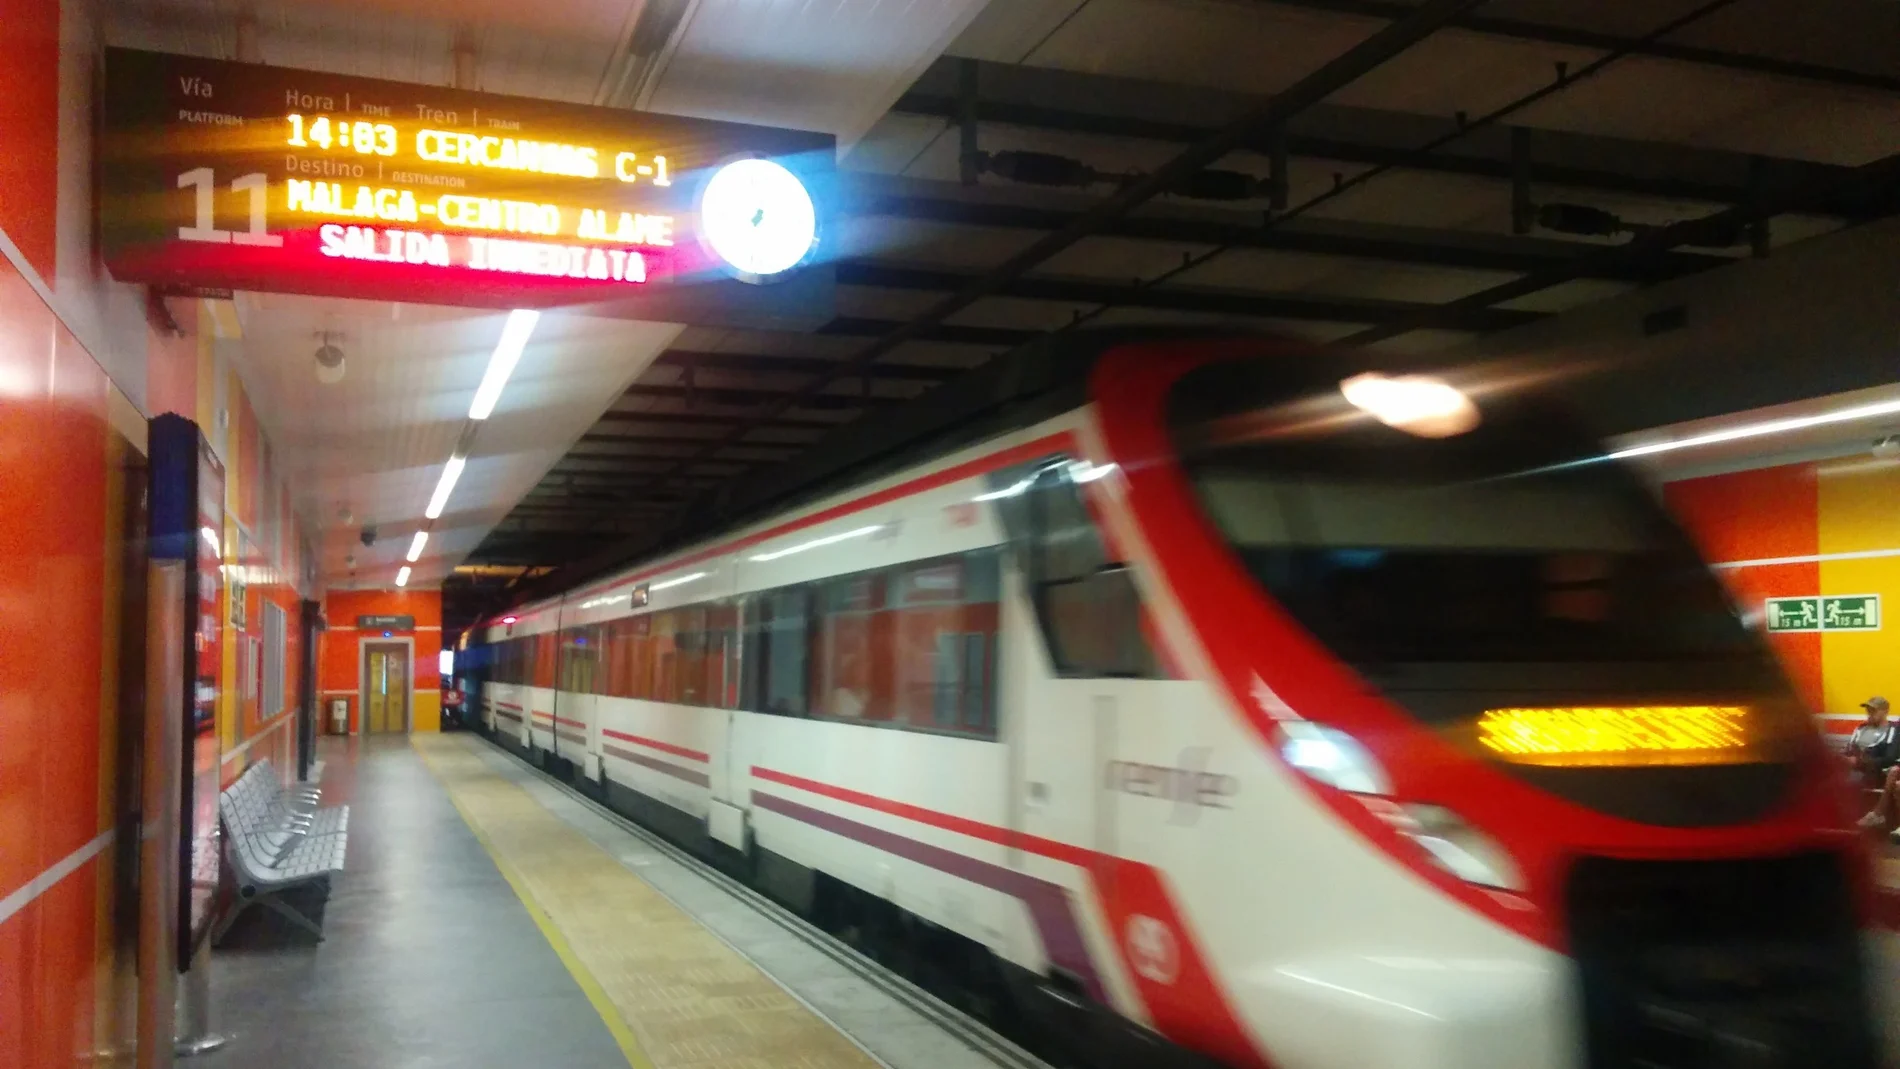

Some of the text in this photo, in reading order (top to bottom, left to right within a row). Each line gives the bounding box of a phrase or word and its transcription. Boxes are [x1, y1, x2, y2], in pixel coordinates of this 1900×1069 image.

[179, 76, 213, 98] Vía
[179, 109, 243, 126] PLATFORM
[285, 88, 520, 131] Hora TIME Tren TRAIN
[286, 155, 466, 189] Destino DESTINATION
[416, 128, 599, 178] CERCANS
[615, 151, 671, 187] C-1
[177, 167, 284, 248] 11
[577, 207, 675, 246] ALAME
[318, 223, 647, 283] SALIDA IEDIATA
